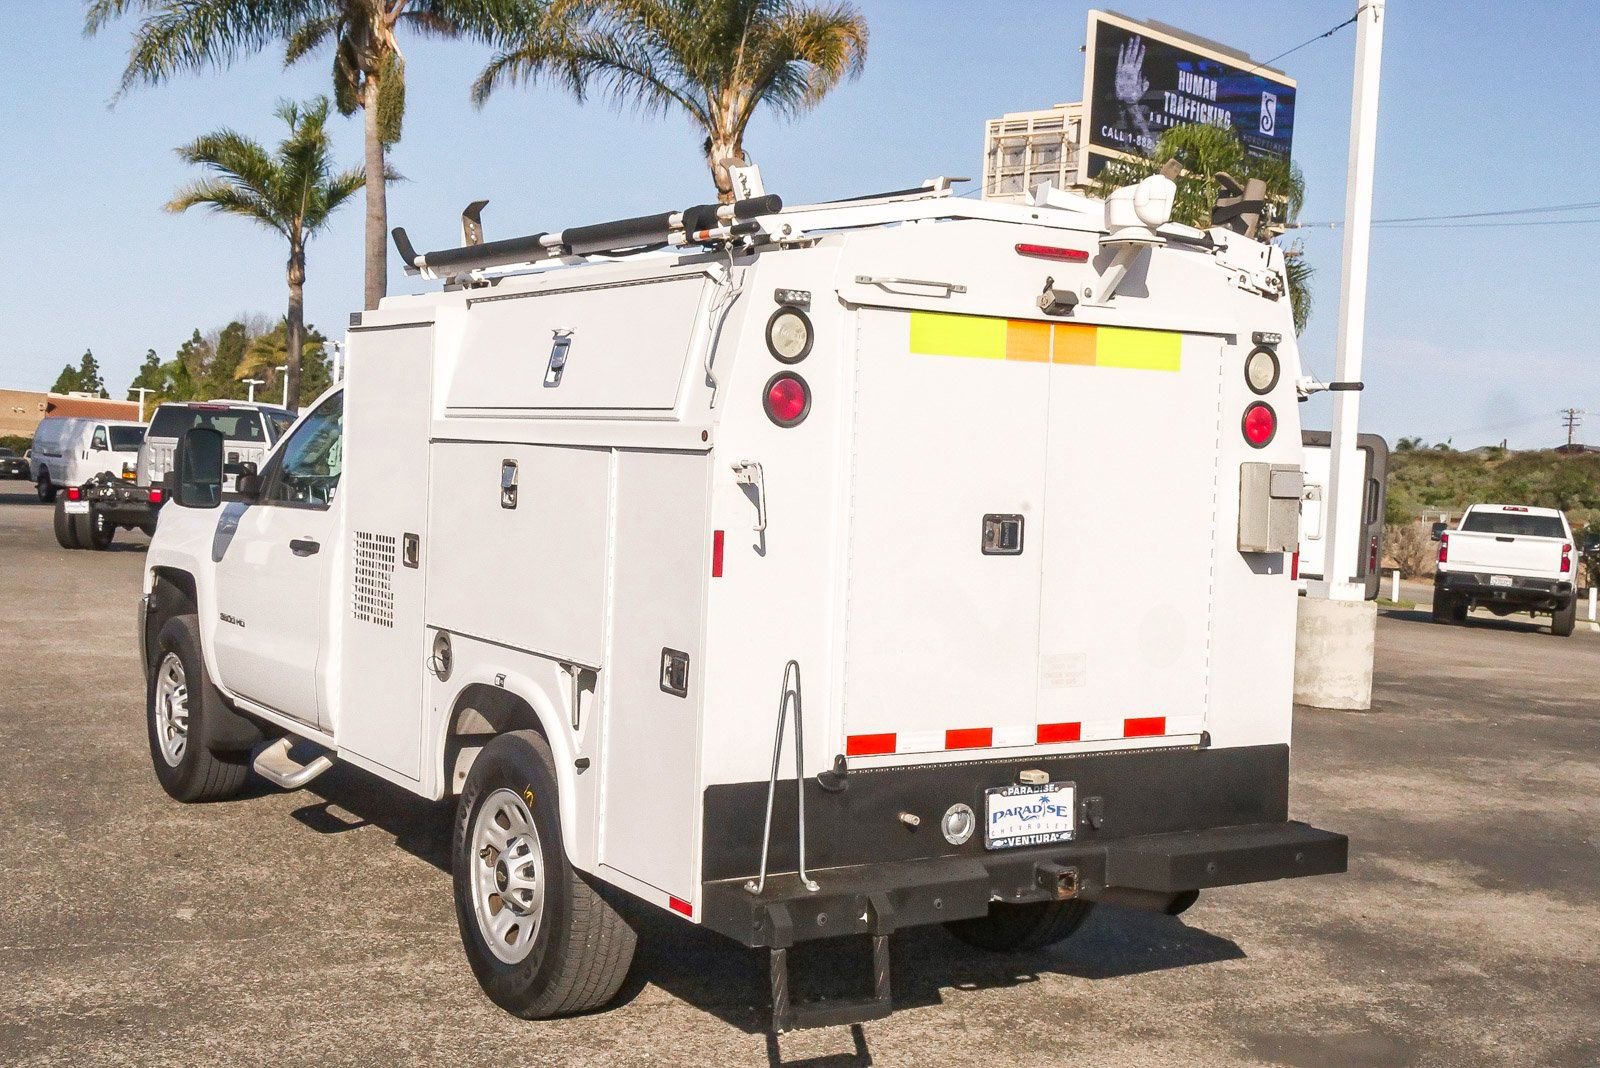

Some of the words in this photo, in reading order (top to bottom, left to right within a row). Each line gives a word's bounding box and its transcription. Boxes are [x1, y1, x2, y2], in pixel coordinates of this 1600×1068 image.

[1178, 70, 1218, 102] HUMAN
[1164, 91, 1231, 129] TRAFFICKING
[1101, 125, 1125, 143] CALL
[1008, 784, 1055, 796] PARADISE
[992, 803, 1067, 824] PARADISE
[992, 823, 1067, 837] CHEVROLET
[1007, 833, 1057, 847] VENTURA
